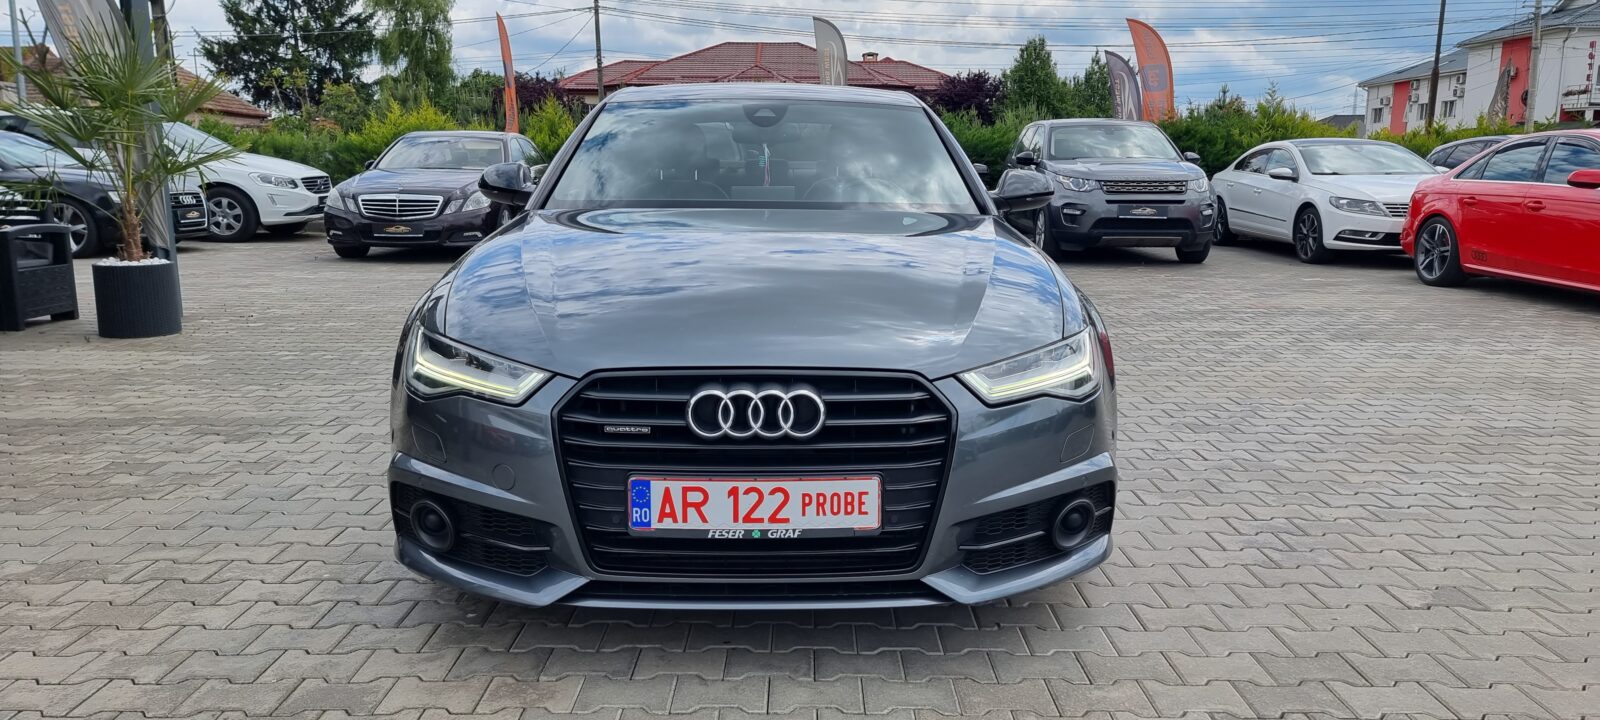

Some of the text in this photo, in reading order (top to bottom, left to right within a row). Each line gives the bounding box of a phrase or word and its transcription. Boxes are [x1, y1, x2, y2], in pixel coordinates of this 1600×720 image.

[657, 486, 869, 524] AR 122 PROBE
[632, 507, 650, 522] RO
[708, 529, 802, 538] FESER GRAF
